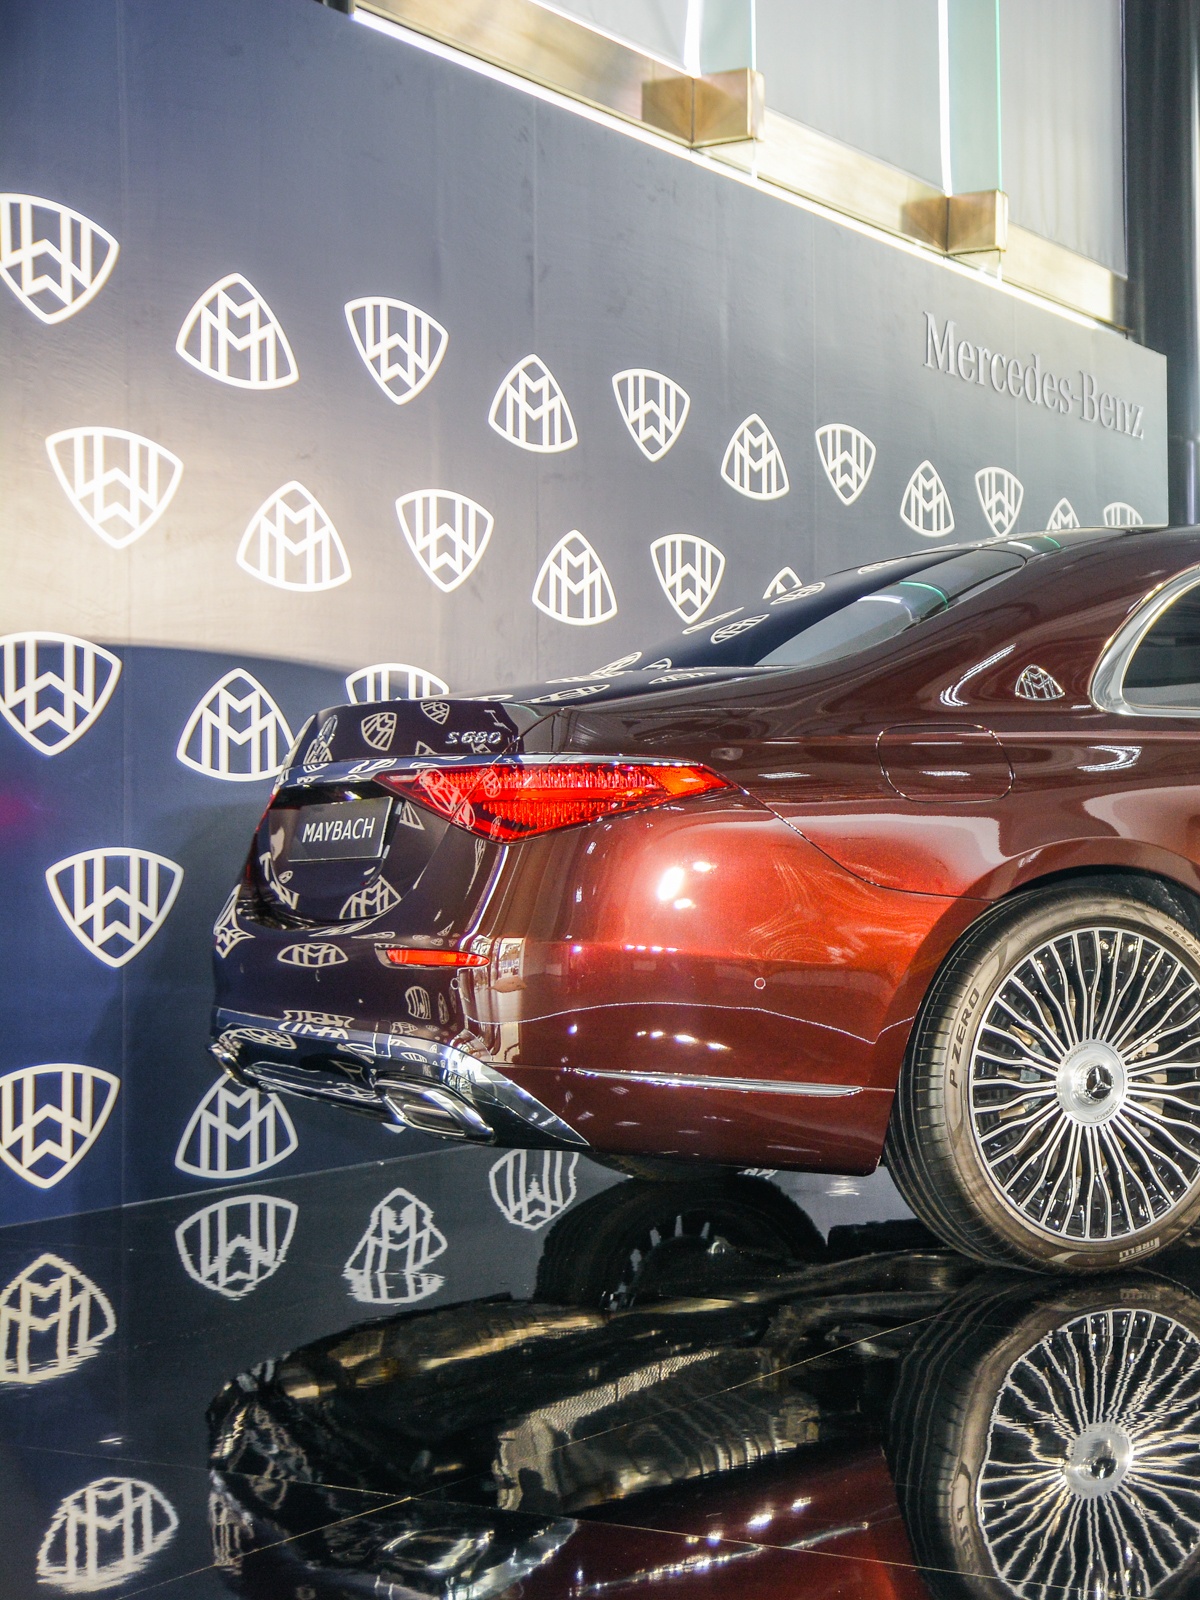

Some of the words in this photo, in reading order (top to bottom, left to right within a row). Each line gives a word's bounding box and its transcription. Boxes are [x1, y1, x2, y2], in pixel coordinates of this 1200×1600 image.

[922, 311, 1145, 440] Mercedes-Benz
[445, 731, 460, 744] S
[461, 731, 501, 744] 680
[302, 817, 376, 843] MAYBACH
[952, 987, 981, 1065] ZERO
[949, 1069, 958, 1089] P
[1119, 1237, 1160, 1263] PIRELLI
